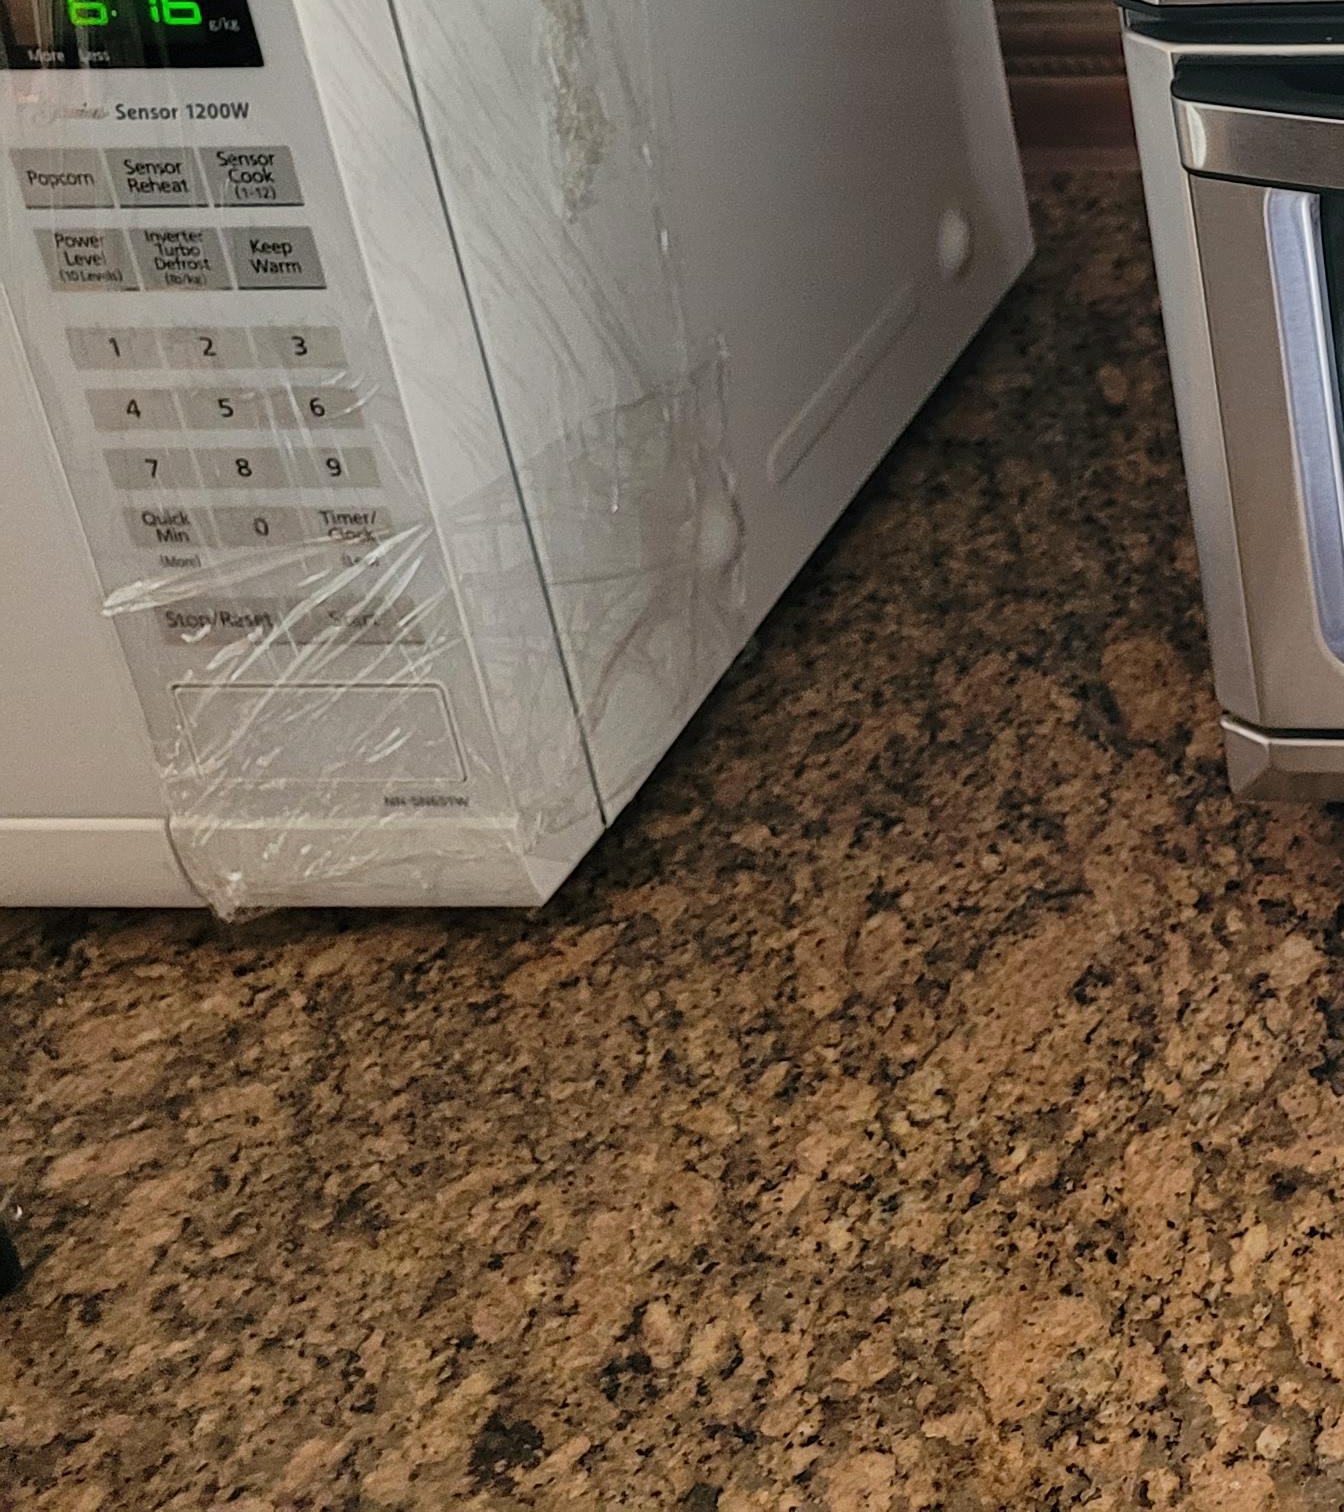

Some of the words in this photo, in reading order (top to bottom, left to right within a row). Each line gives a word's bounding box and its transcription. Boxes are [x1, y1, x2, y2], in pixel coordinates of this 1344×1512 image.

[115, 102, 178, 120] Sensor
[187, 101, 250, 119] 1200W
[216, 150, 275, 167] Sensor
[124, 160, 182, 175] Sensor
[228, 167, 275, 183] Cook
[27, 169, 95, 188] Popcorn
[127, 177, 190, 194] Reheat
[235, 186, 277, 200] (1-12)
[54, 232, 105, 248] Power
[250, 240, 293, 256] Keep
[63, 250, 107, 266] Level
[154, 242, 201, 257] Turbo
[251, 258, 302, 274] Warm
[110, 337, 121, 356] 1
[200, 337, 217, 356] 2
[292, 336, 308, 355] 3
[126, 399, 141, 418] 4
[218, 399, 234, 418] 5
[310, 398, 325, 418] 6
[145, 459, 160, 478] 7
[235, 458, 252, 478] 8
[326, 458, 342, 478] 9
[141, 511, 190, 528] Quick
[319, 510, 376, 526] Timer/
[254, 518, 269, 536] 0
[156, 529, 190, 543] Min
